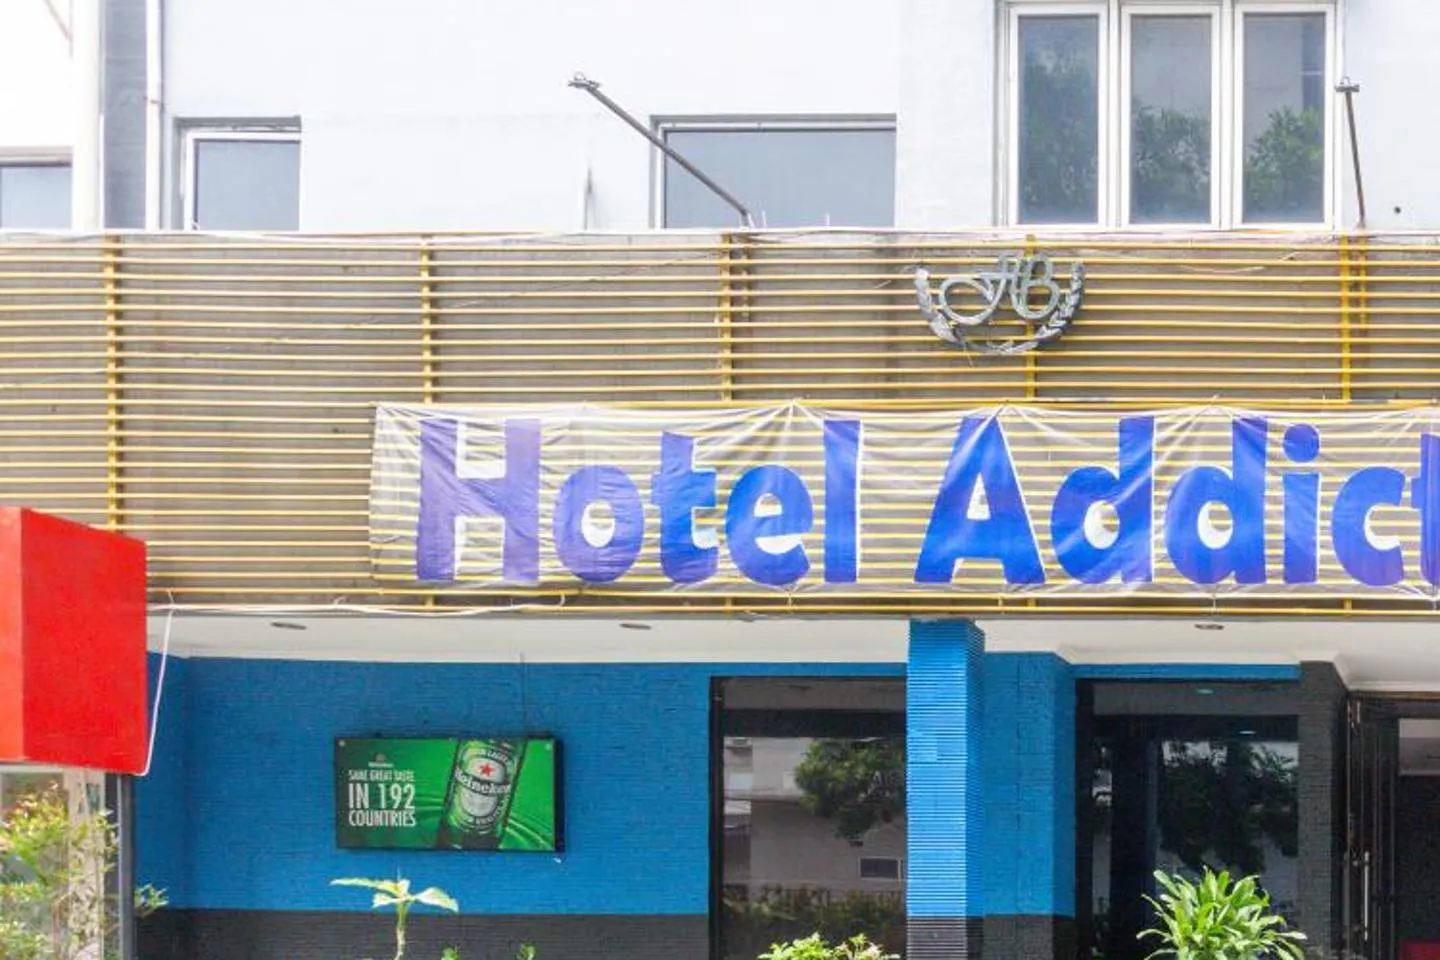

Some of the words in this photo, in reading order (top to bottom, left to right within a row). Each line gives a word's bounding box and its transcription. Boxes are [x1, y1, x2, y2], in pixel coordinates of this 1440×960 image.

[416, 418, 861, 586] Hotel
[348, 783, 369, 809] IN
[378, 783, 415, 809] 192
[348, 810, 416, 827] COUNTRIES
